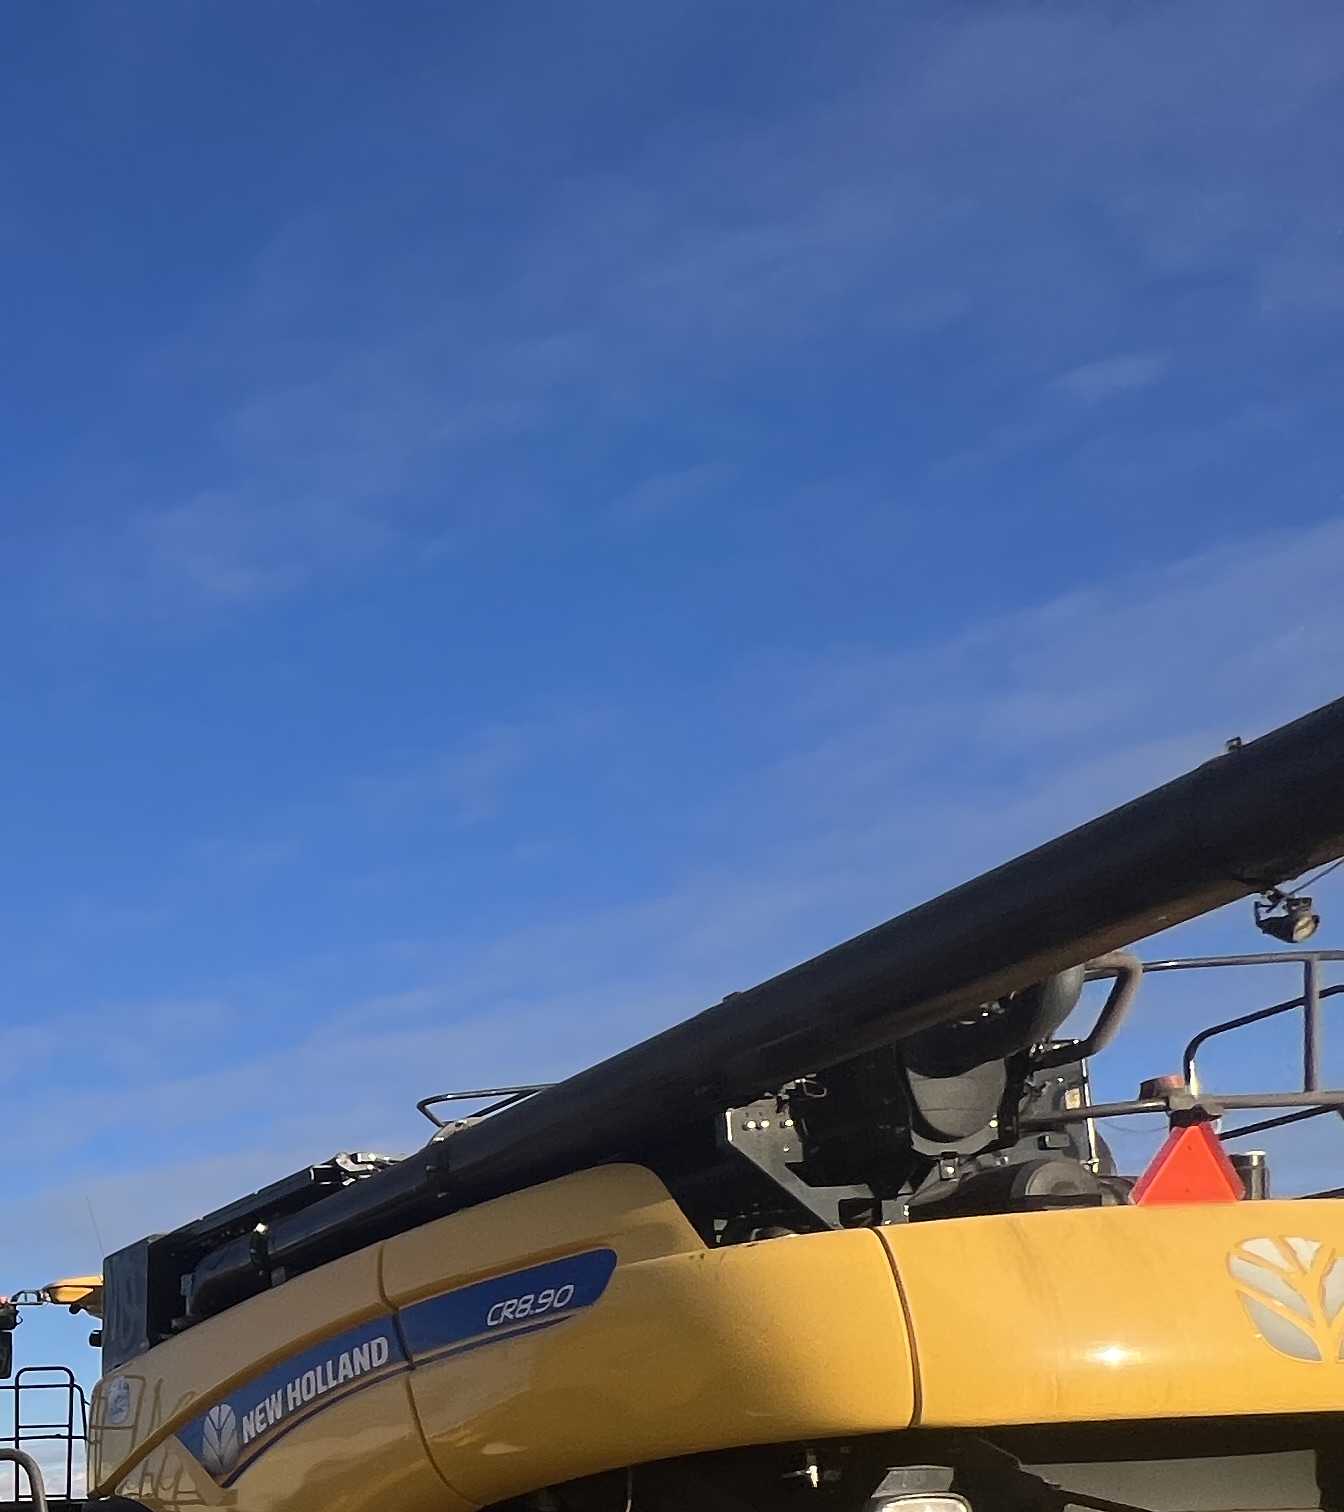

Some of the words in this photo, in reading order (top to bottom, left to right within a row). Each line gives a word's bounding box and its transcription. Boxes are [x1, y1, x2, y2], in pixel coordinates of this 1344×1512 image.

[486, 1284, 575, 1326] CR8.90
[242, 1388, 283, 1444] NEW
[286, 1336, 389, 1412] HOLLAND
